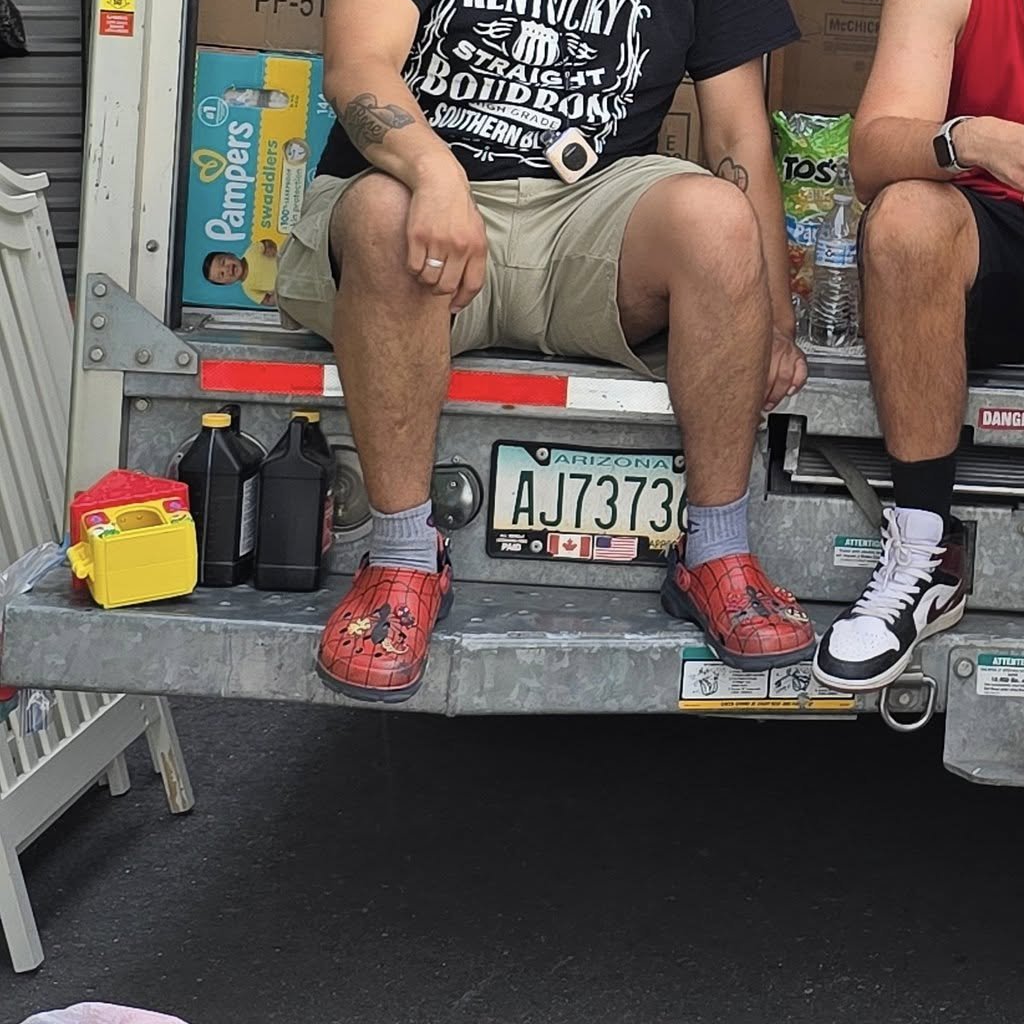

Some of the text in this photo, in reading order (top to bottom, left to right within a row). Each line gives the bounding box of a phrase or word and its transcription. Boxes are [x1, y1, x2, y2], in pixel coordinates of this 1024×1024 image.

[829, 18, 880, 32] McCHIC
[452, 39, 606, 89] STRAIGHT
[420, 53, 611, 124] BOURBON
[430, 102, 542, 150] SOUTHERN BL
[204, 120, 255, 242] Pampers
[260, 140, 279, 229] swaddlers
[784, 156, 838, 184] TOS
[554, 454, 669, 469] ARIZONA
[501, 543, 521, 552] PAID
[845, 538, 880, 547] ATTENTIO
